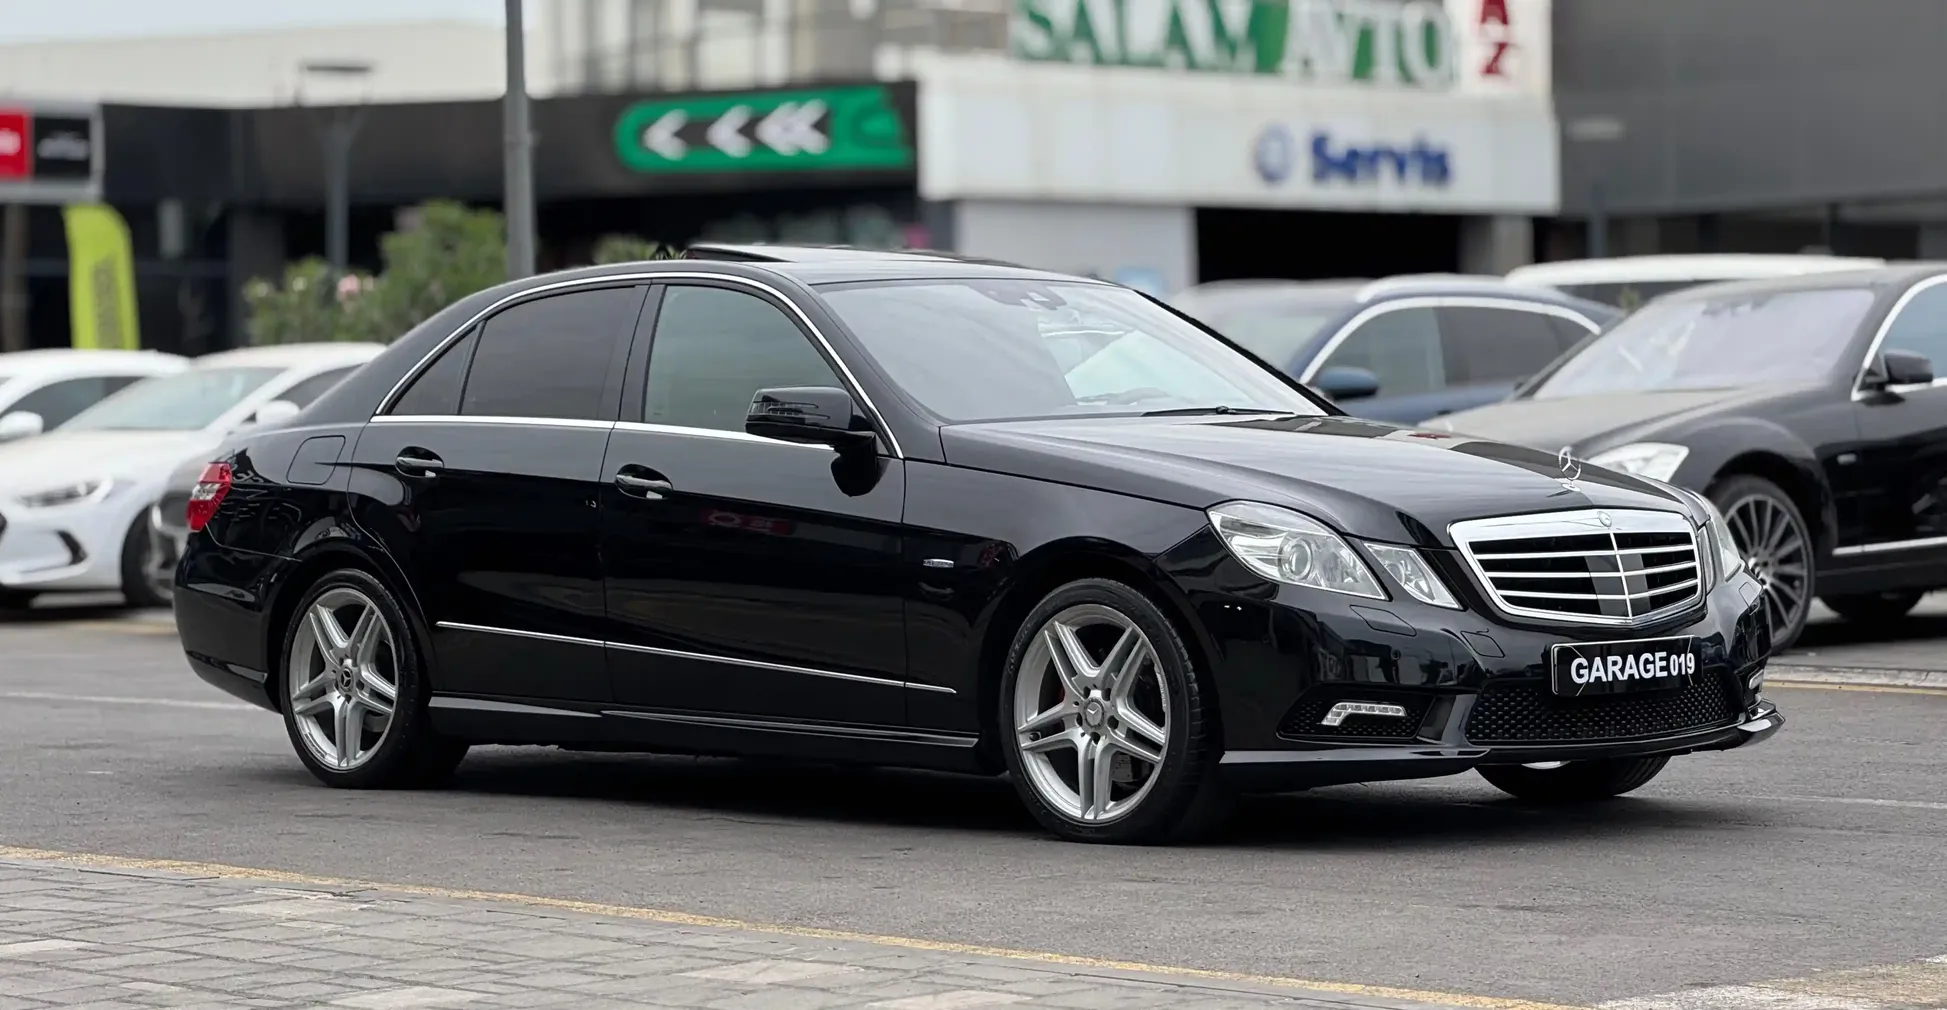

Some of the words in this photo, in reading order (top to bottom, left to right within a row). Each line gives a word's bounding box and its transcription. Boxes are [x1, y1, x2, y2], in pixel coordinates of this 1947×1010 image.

[1310, 130, 1452, 187] Servis
[1570, 651, 1668, 684] GARAGE
[1669, 652, 1696, 676] 019
